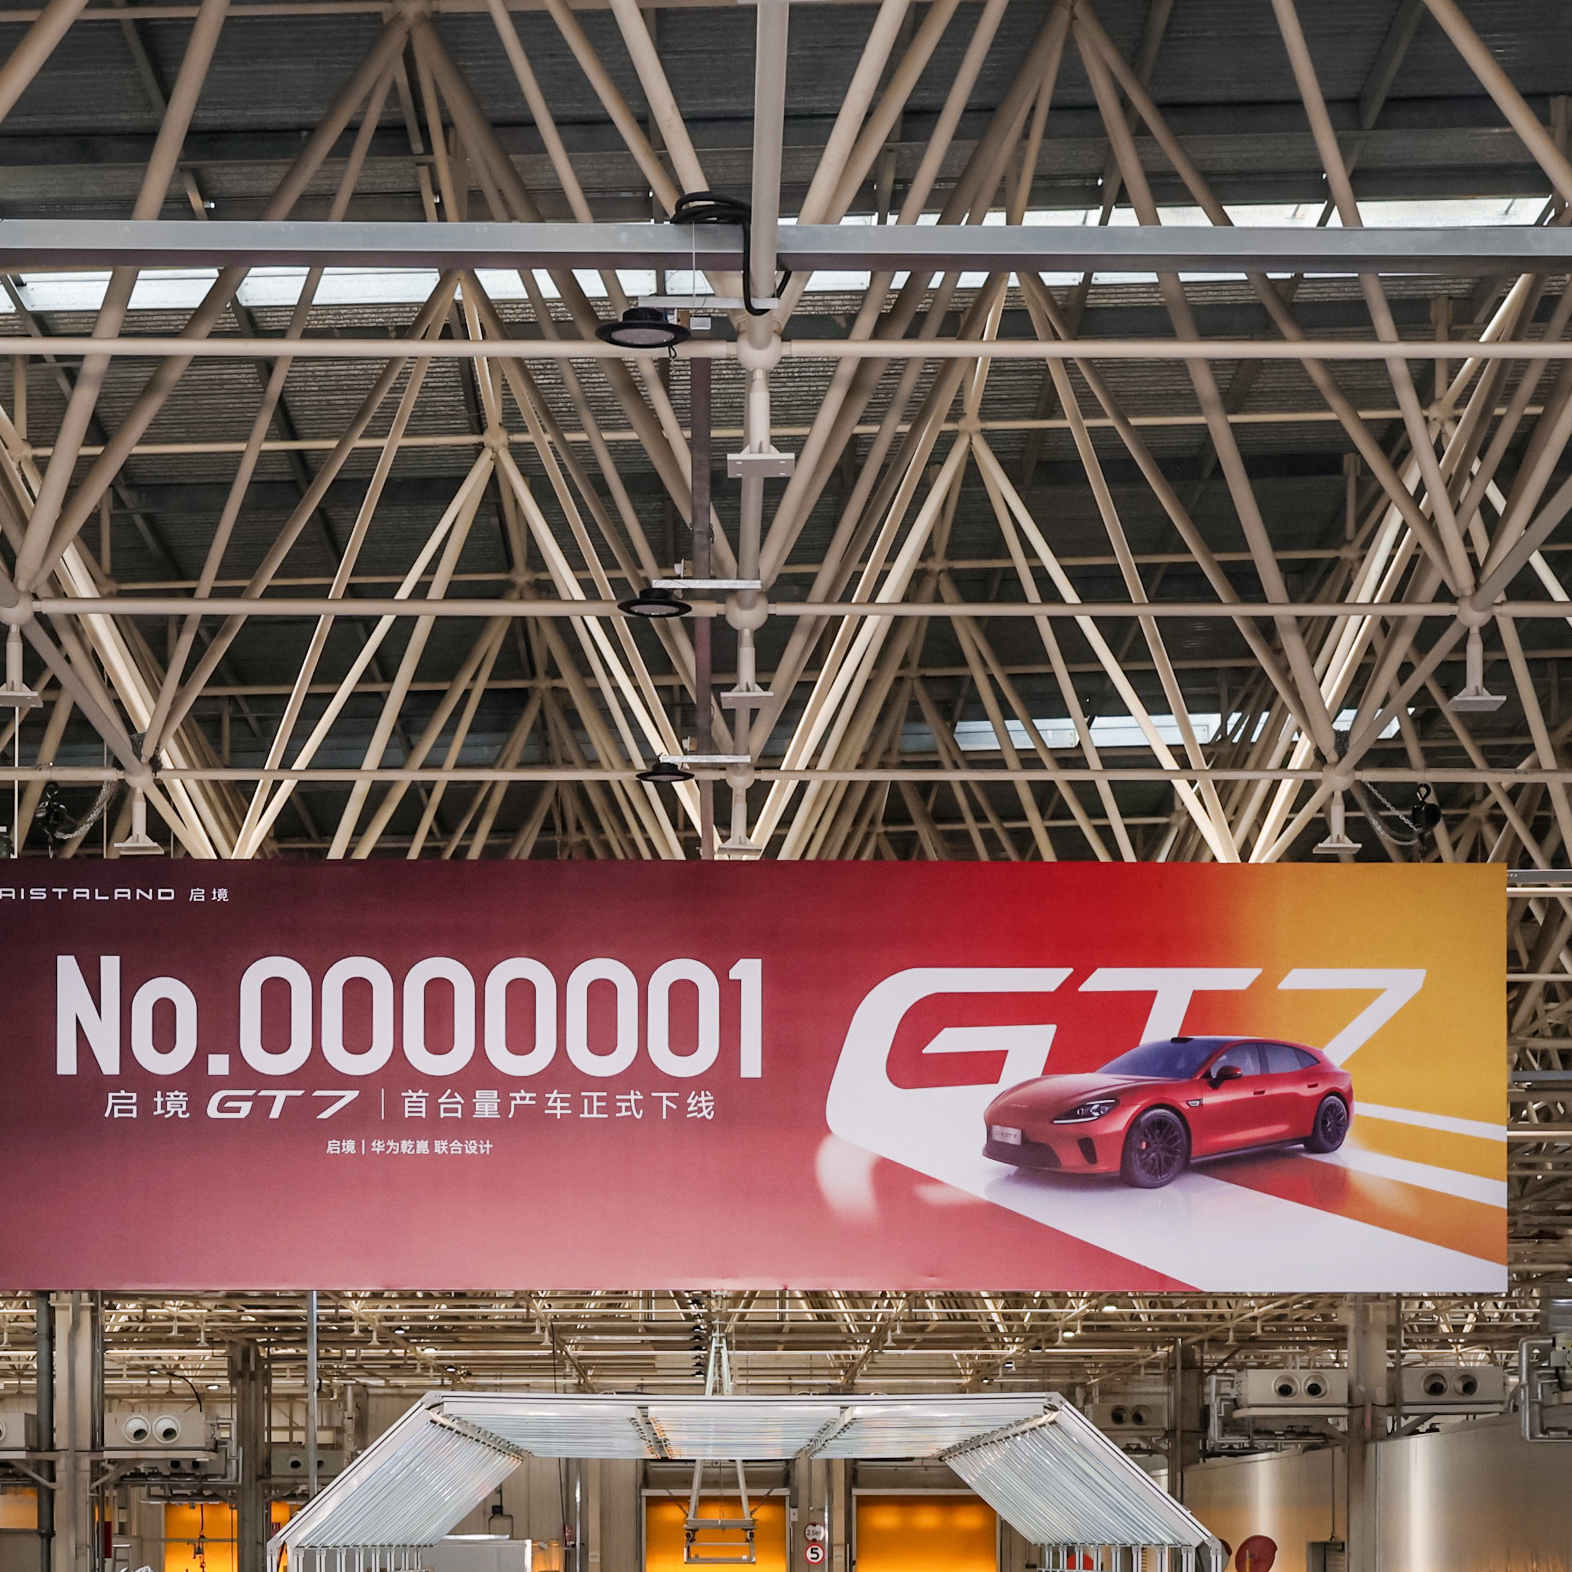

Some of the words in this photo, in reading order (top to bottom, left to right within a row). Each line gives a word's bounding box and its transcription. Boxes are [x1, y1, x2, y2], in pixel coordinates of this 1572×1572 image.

[188, 887, 230, 902] 启境
[55, 955, 763, 1079] No.0000001
[825, 967, 1427, 1142] GT7
[104, 1089, 191, 1119] 启境
[206, 1089, 360, 1119] GT7
[401, 1087, 715, 1120] 首台量产车正式下线
[326, 1138, 357, 1155] 启境
[433, 1138, 494, 1155] 联合设计
[810, 1547, 820, 1560] 5
